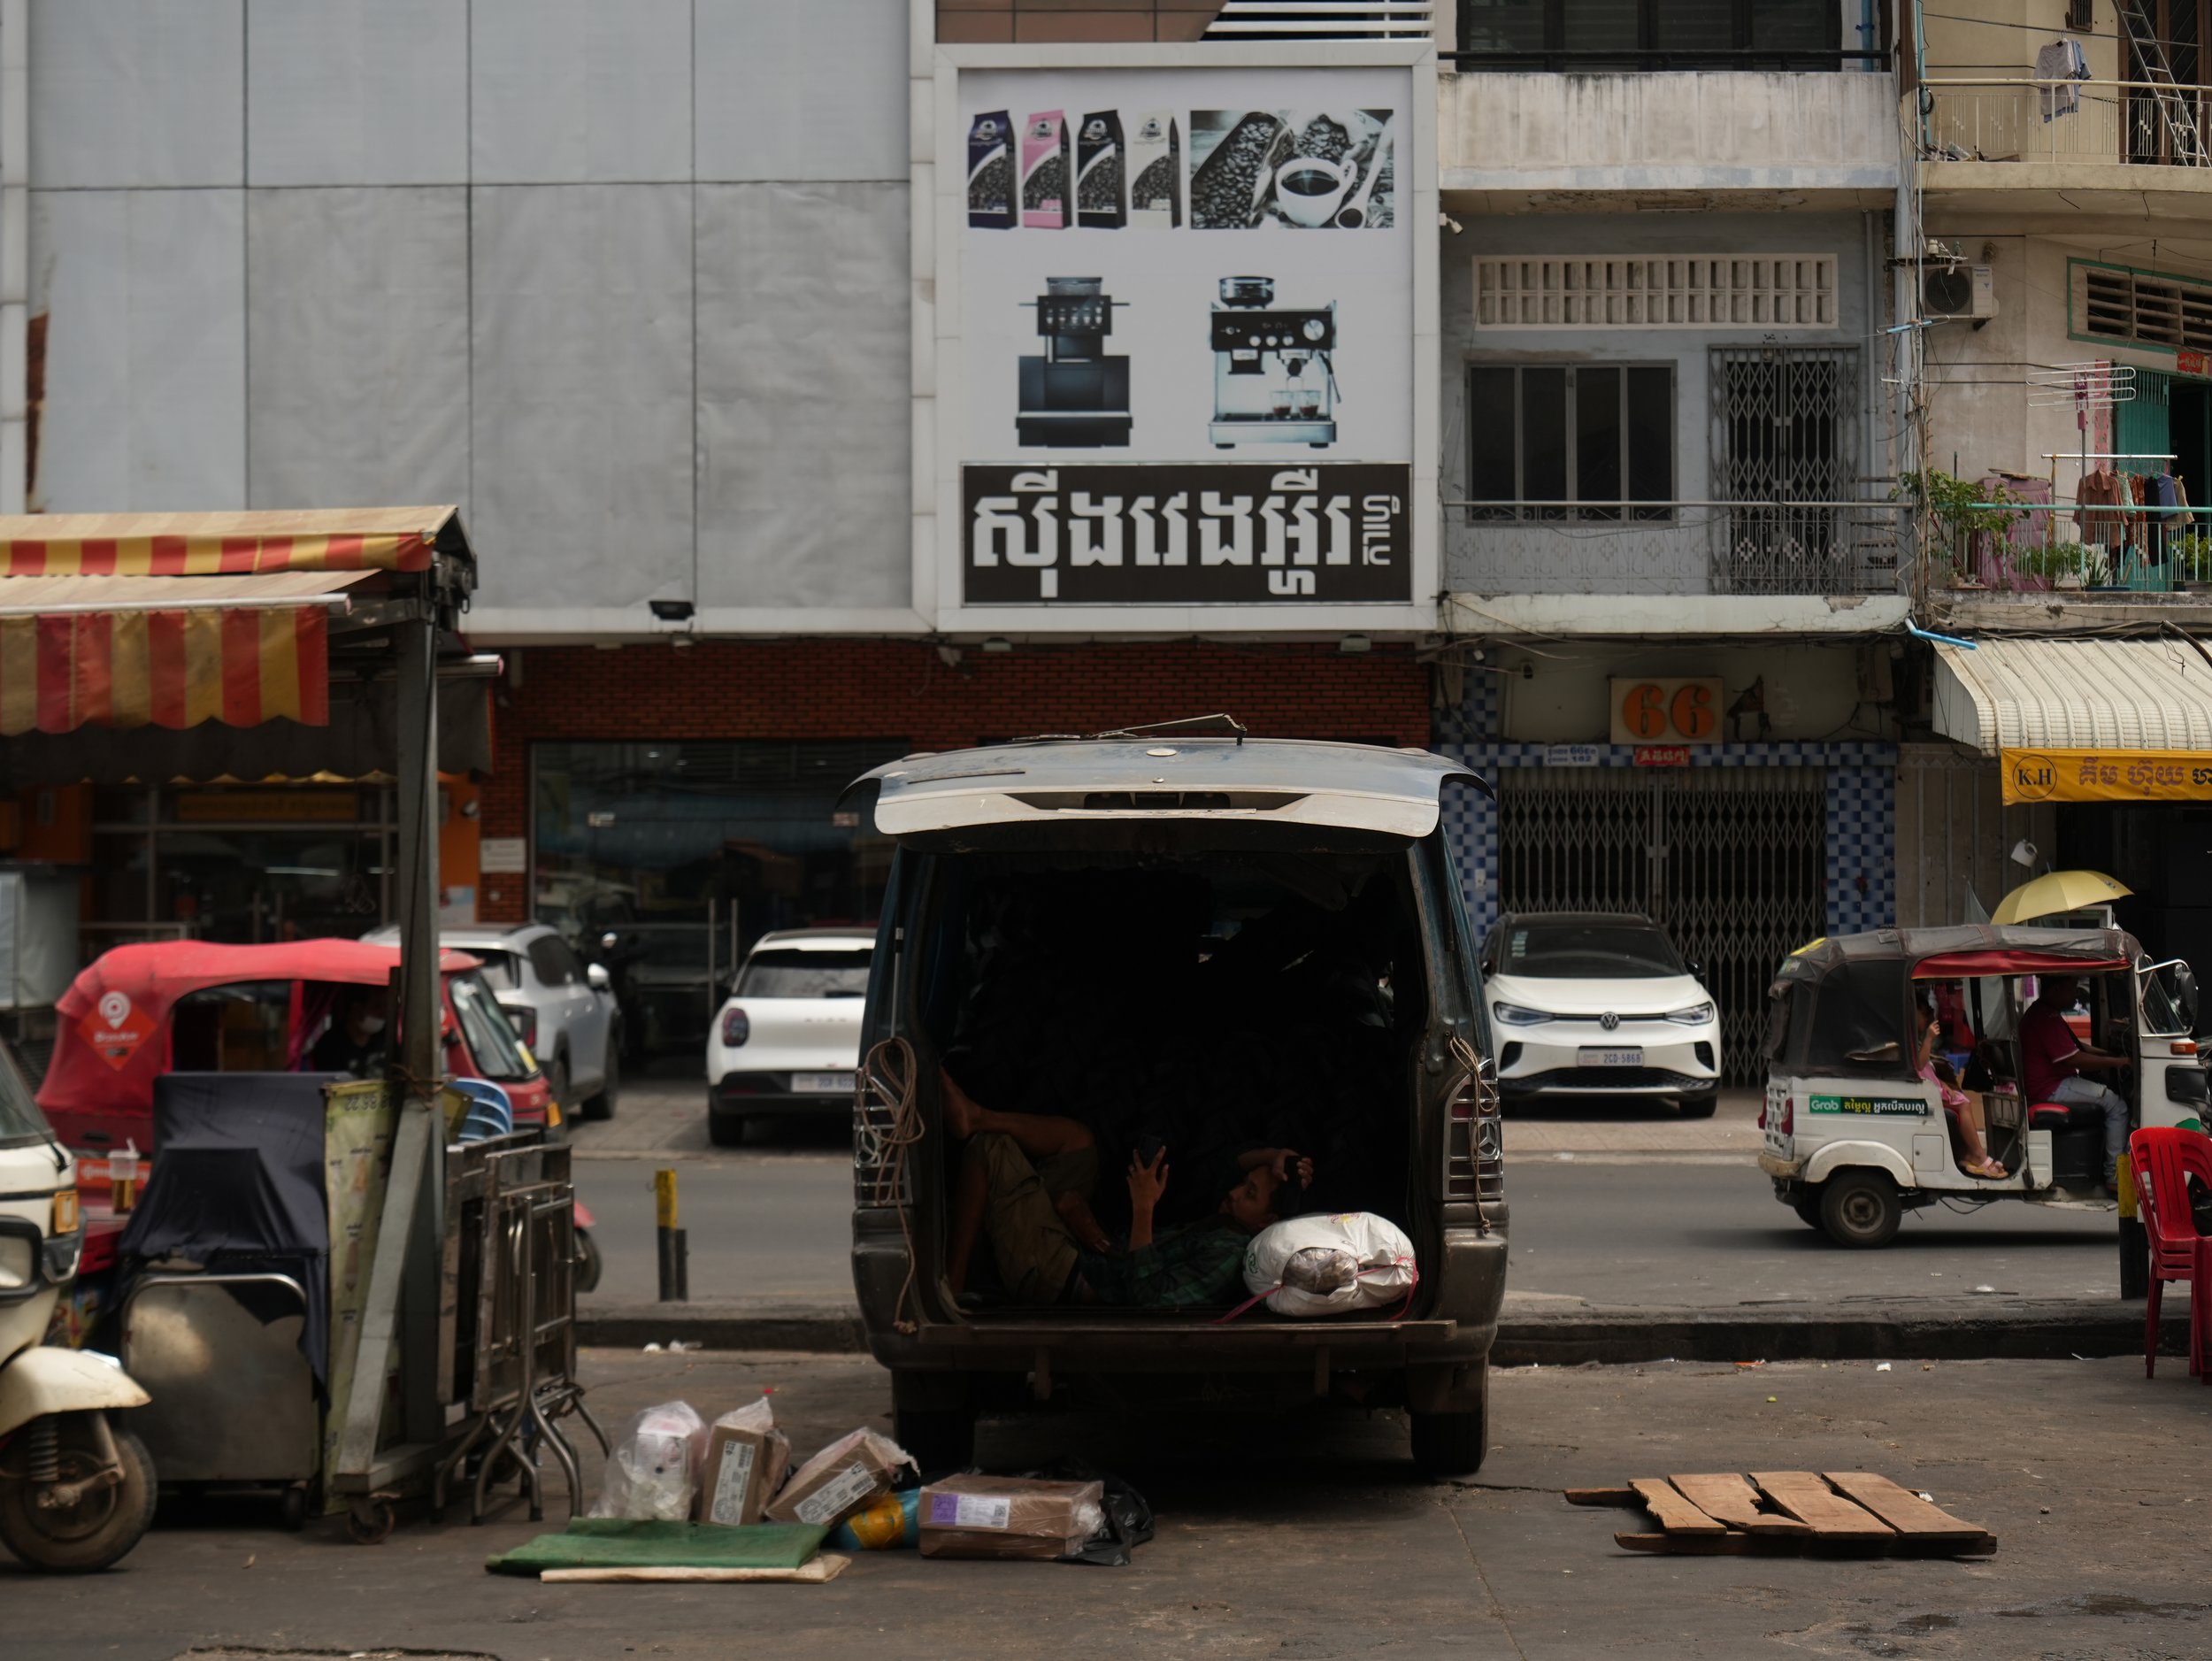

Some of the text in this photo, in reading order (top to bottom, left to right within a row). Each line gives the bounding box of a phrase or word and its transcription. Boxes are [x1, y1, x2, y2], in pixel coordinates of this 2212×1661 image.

[1623, 683, 1715, 739] 66
[2018, 768, 2052, 786] K.H
[1810, 1099, 1839, 1111] Grab
